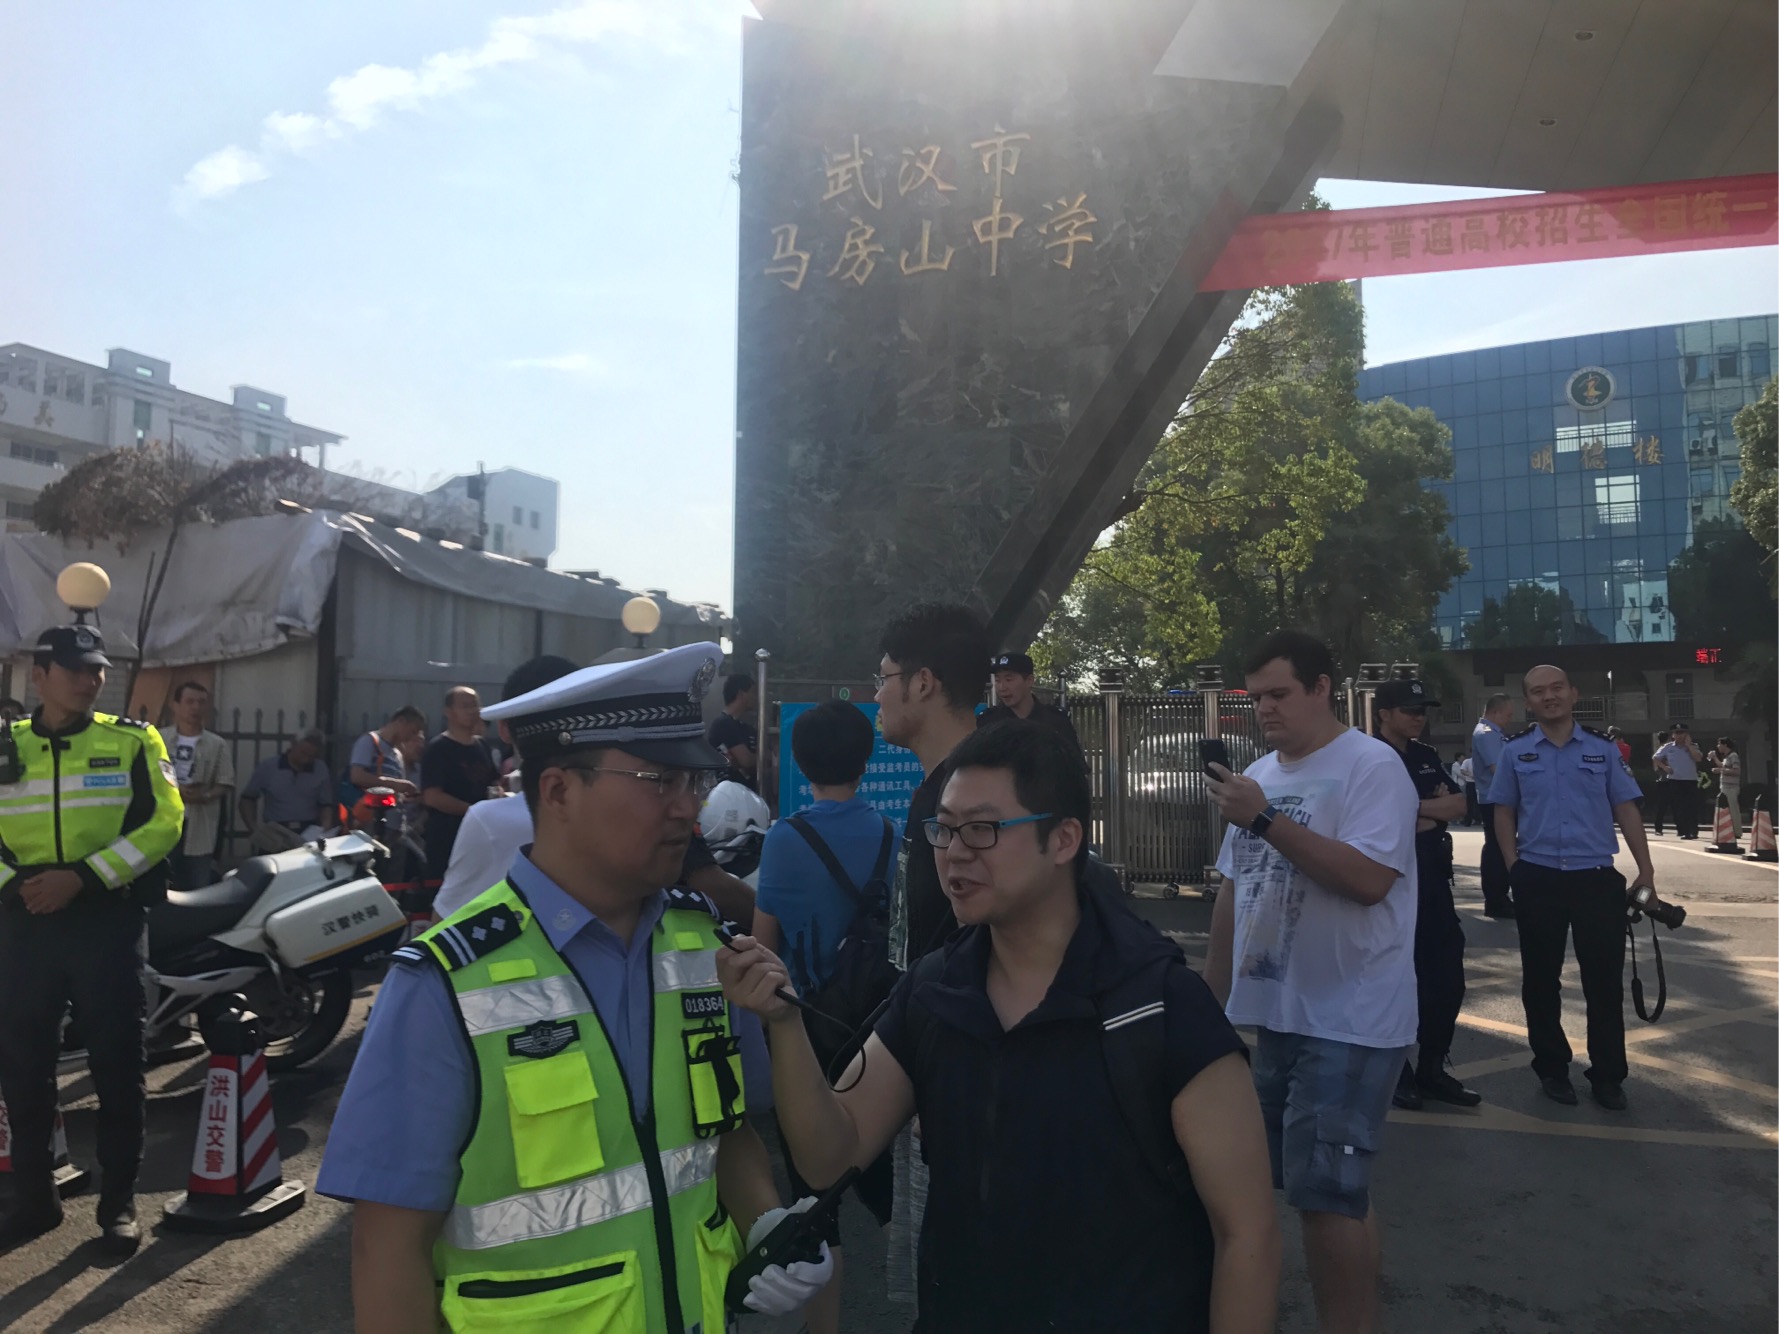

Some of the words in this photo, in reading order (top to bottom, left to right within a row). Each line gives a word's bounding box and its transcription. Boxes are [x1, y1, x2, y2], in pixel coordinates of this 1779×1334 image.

[823, 123, 1030, 209] 武汉市
[764, 190, 1098, 290] 马房山中学
[685, 996, 724, 1013] 018364
[205, 1074, 231, 1173] 洪山交警
